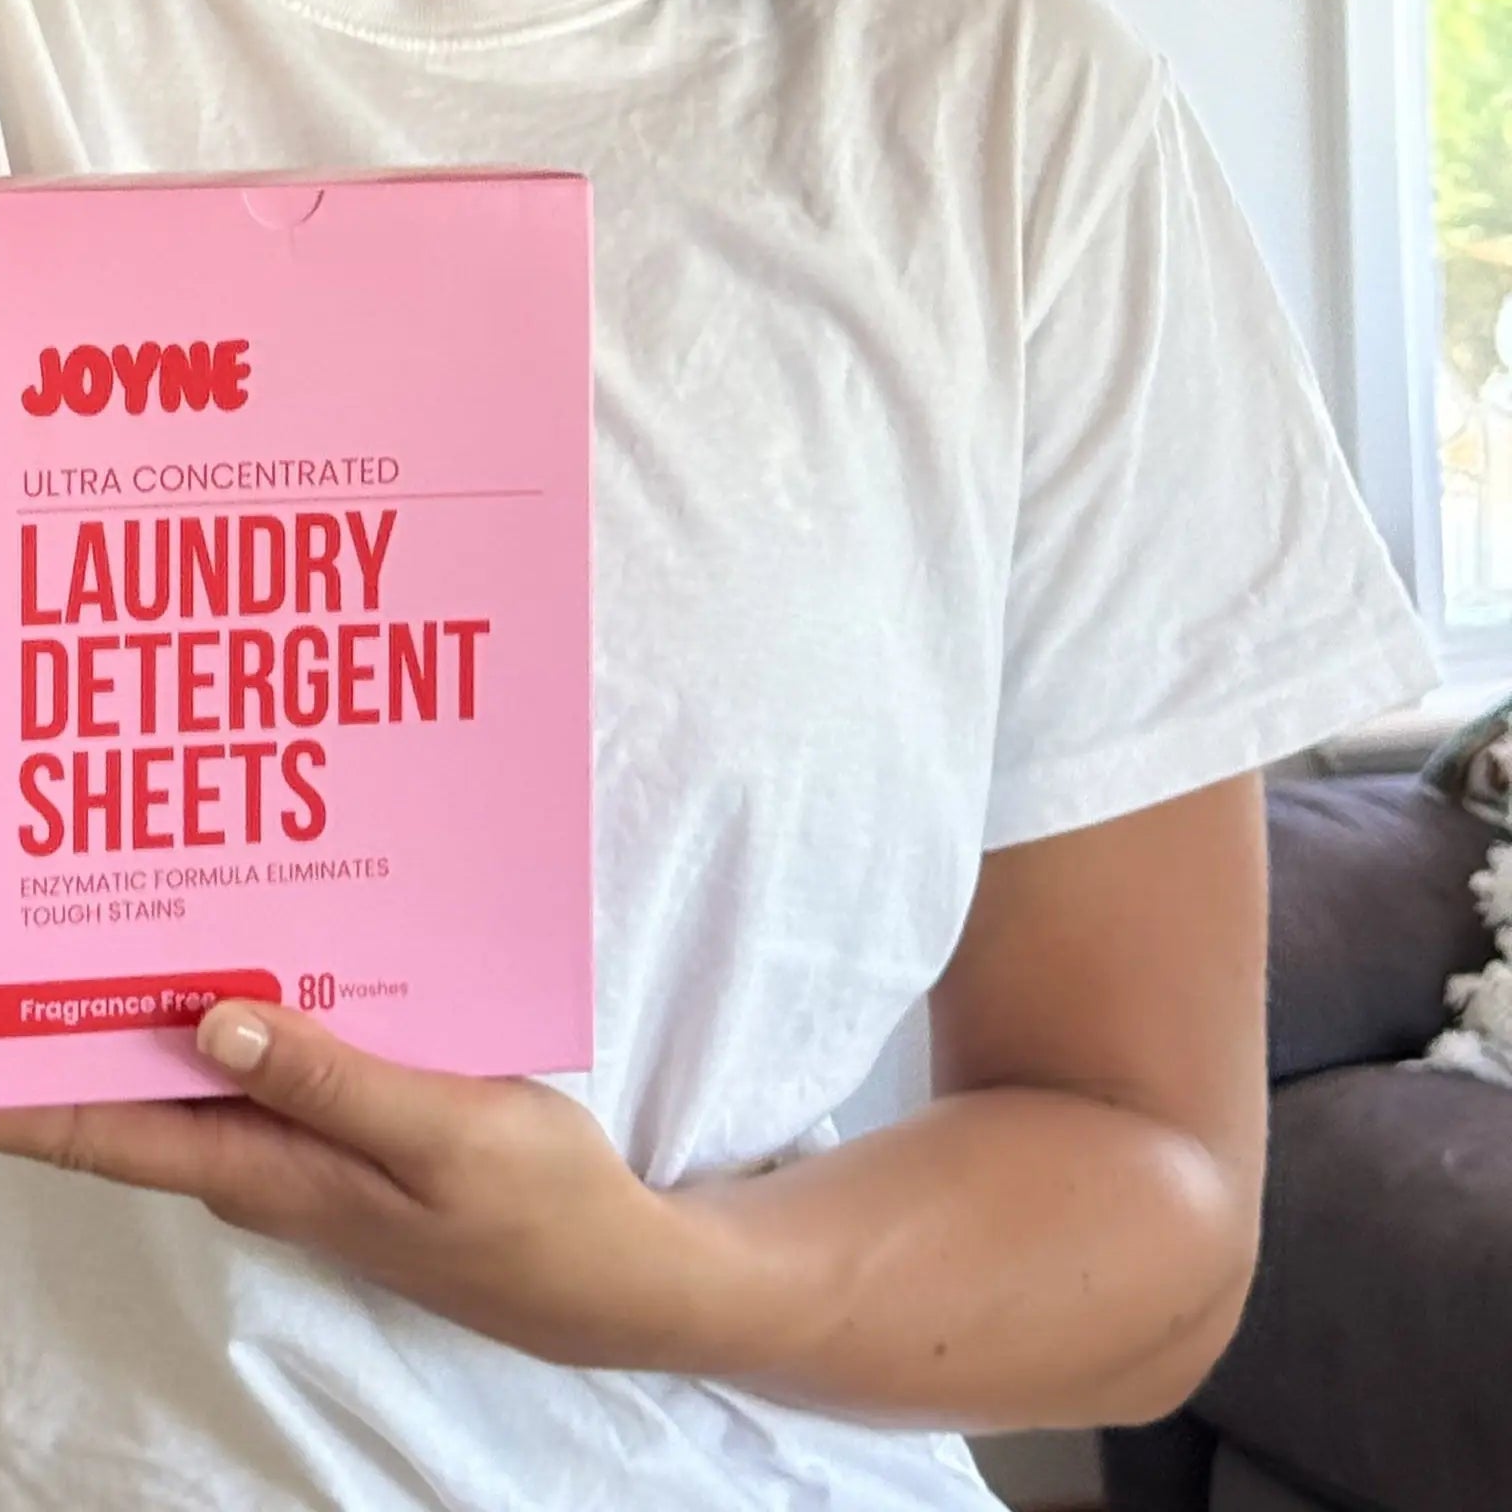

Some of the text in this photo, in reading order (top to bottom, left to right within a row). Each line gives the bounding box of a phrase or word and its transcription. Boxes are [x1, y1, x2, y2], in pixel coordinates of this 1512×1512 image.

[21, 339, 251, 416] JOYNE
[23, 456, 400, 498] ULTRA CONCENTRATED
[21, 509, 398, 626] LAUNDRY
[21, 619, 490, 740] DETERGENT
[18, 739, 327, 857] SHEETS
[20, 857, 390, 898] ENZYMATIC FORMULA ELIMINATES
[21, 897, 186, 927] TOUGH STAINS
[20, 994, 156, 1026] Fragrance
[298, 973, 335, 1011] 80
